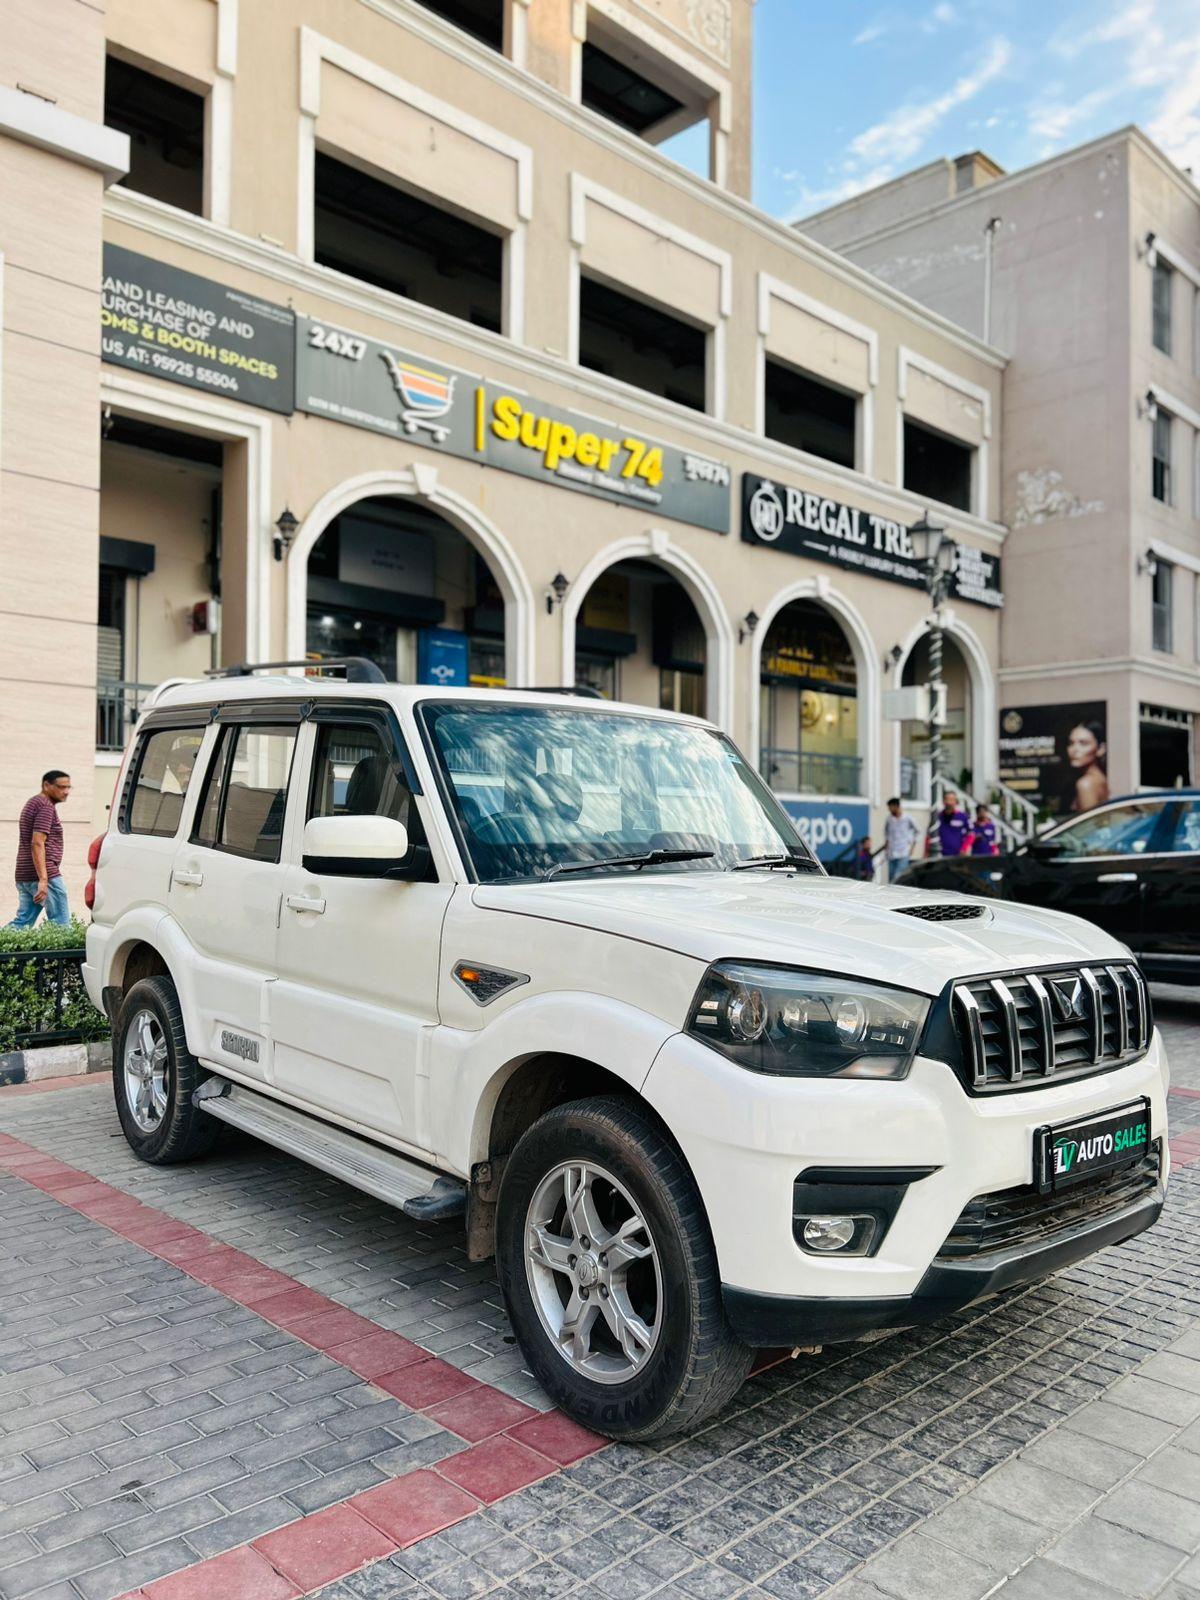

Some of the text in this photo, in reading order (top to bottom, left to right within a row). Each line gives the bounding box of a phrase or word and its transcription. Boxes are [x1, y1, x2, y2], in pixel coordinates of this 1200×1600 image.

[101, 276, 143, 300] AND
[146, 290, 216, 326] LEASING
[218, 317, 254, 339] AND
[102, 292, 211, 341] URCHASE OF
[100, 309, 278, 380] OMS & BOOTH SPACES
[102, 337, 239, 392] US AT: 95925 55504
[309, 325, 367, 361] 24X7
[491, 395, 620, 471] Super
[622, 438, 664, 487] 74
[785, 486, 914, 559] REGAL TRE
[790, 812, 853, 851] epto
[1077, 1133, 1113, 1163] AUTO
[1114, 1122, 1147, 1152] SALES
